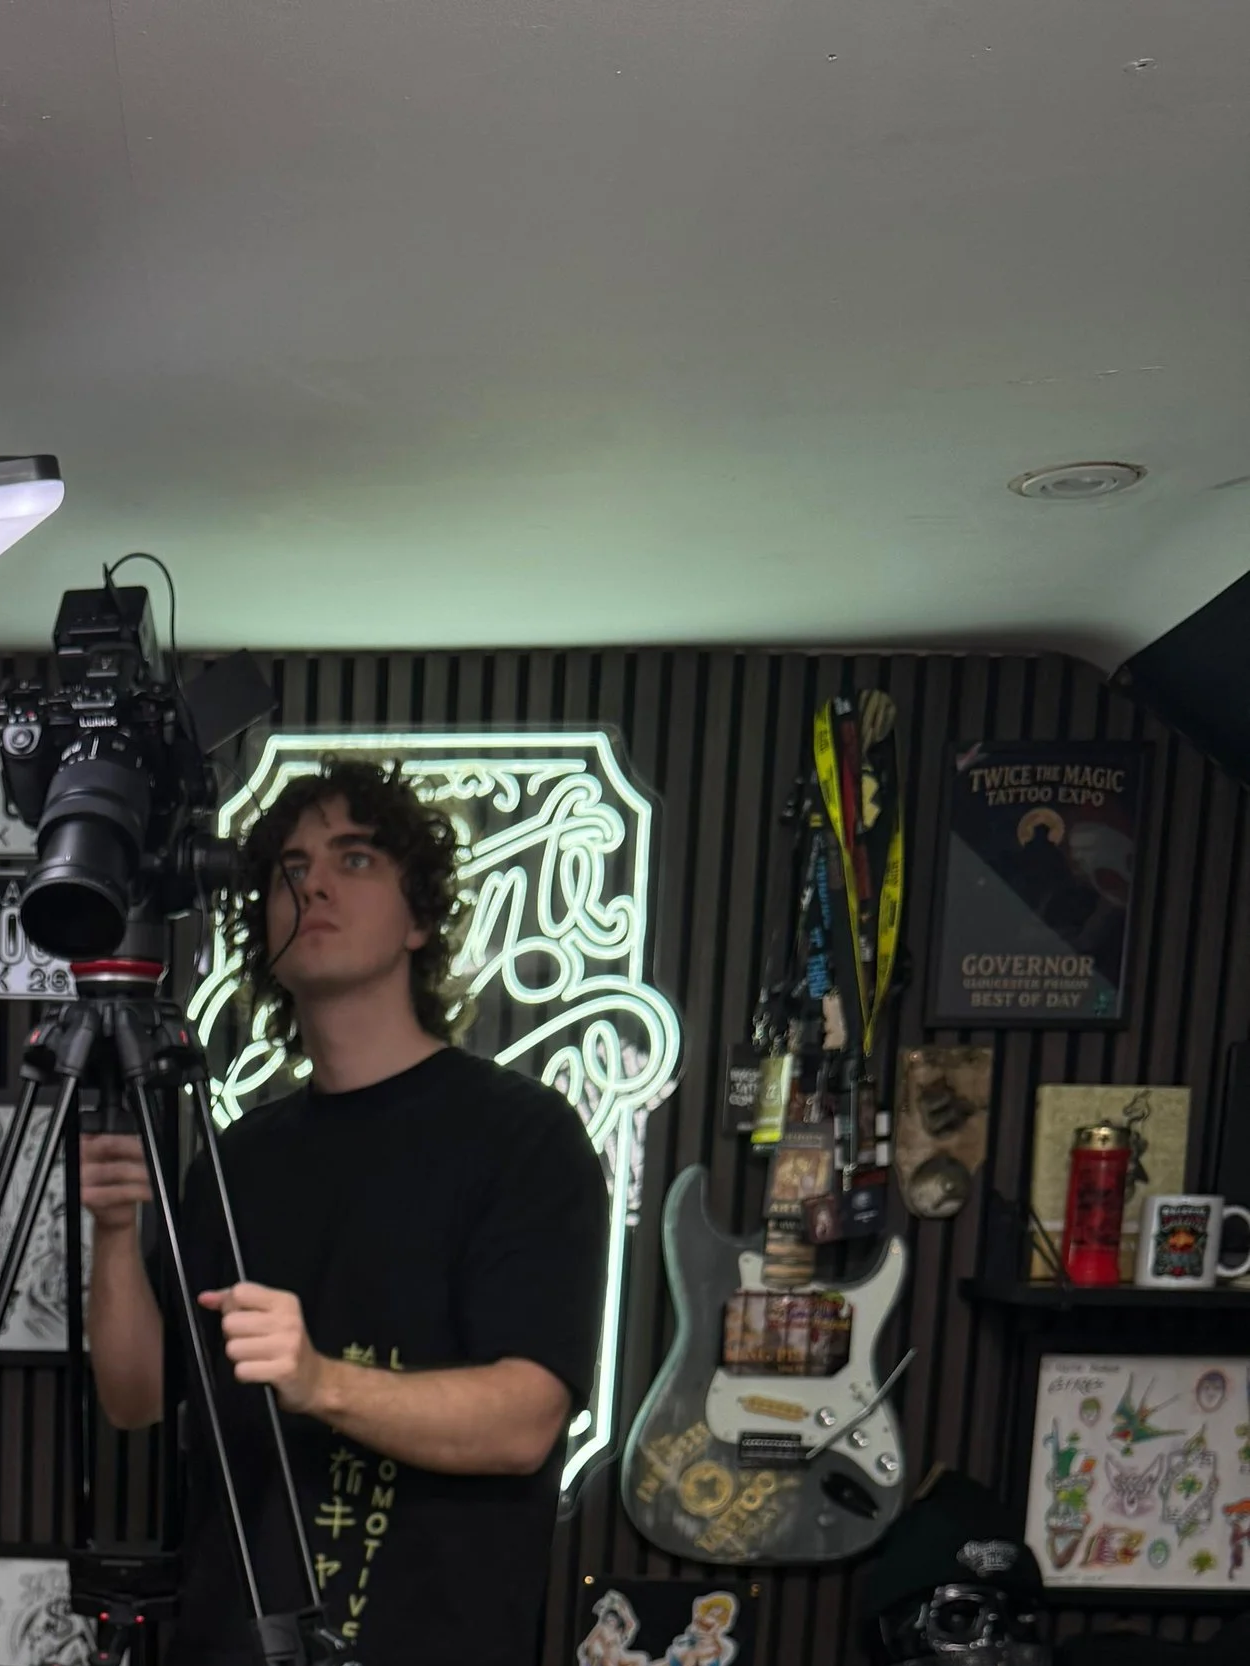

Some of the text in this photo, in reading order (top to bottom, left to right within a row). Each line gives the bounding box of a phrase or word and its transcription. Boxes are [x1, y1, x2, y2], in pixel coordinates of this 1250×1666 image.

[969, 765, 1126, 793] TWICE THE MAGIC
[985, 786, 1105, 807] TATTOO EXPO
[961, 953, 1095, 976] GOVERNOR
[971, 991, 1082, 1008] BEST OF DAY
